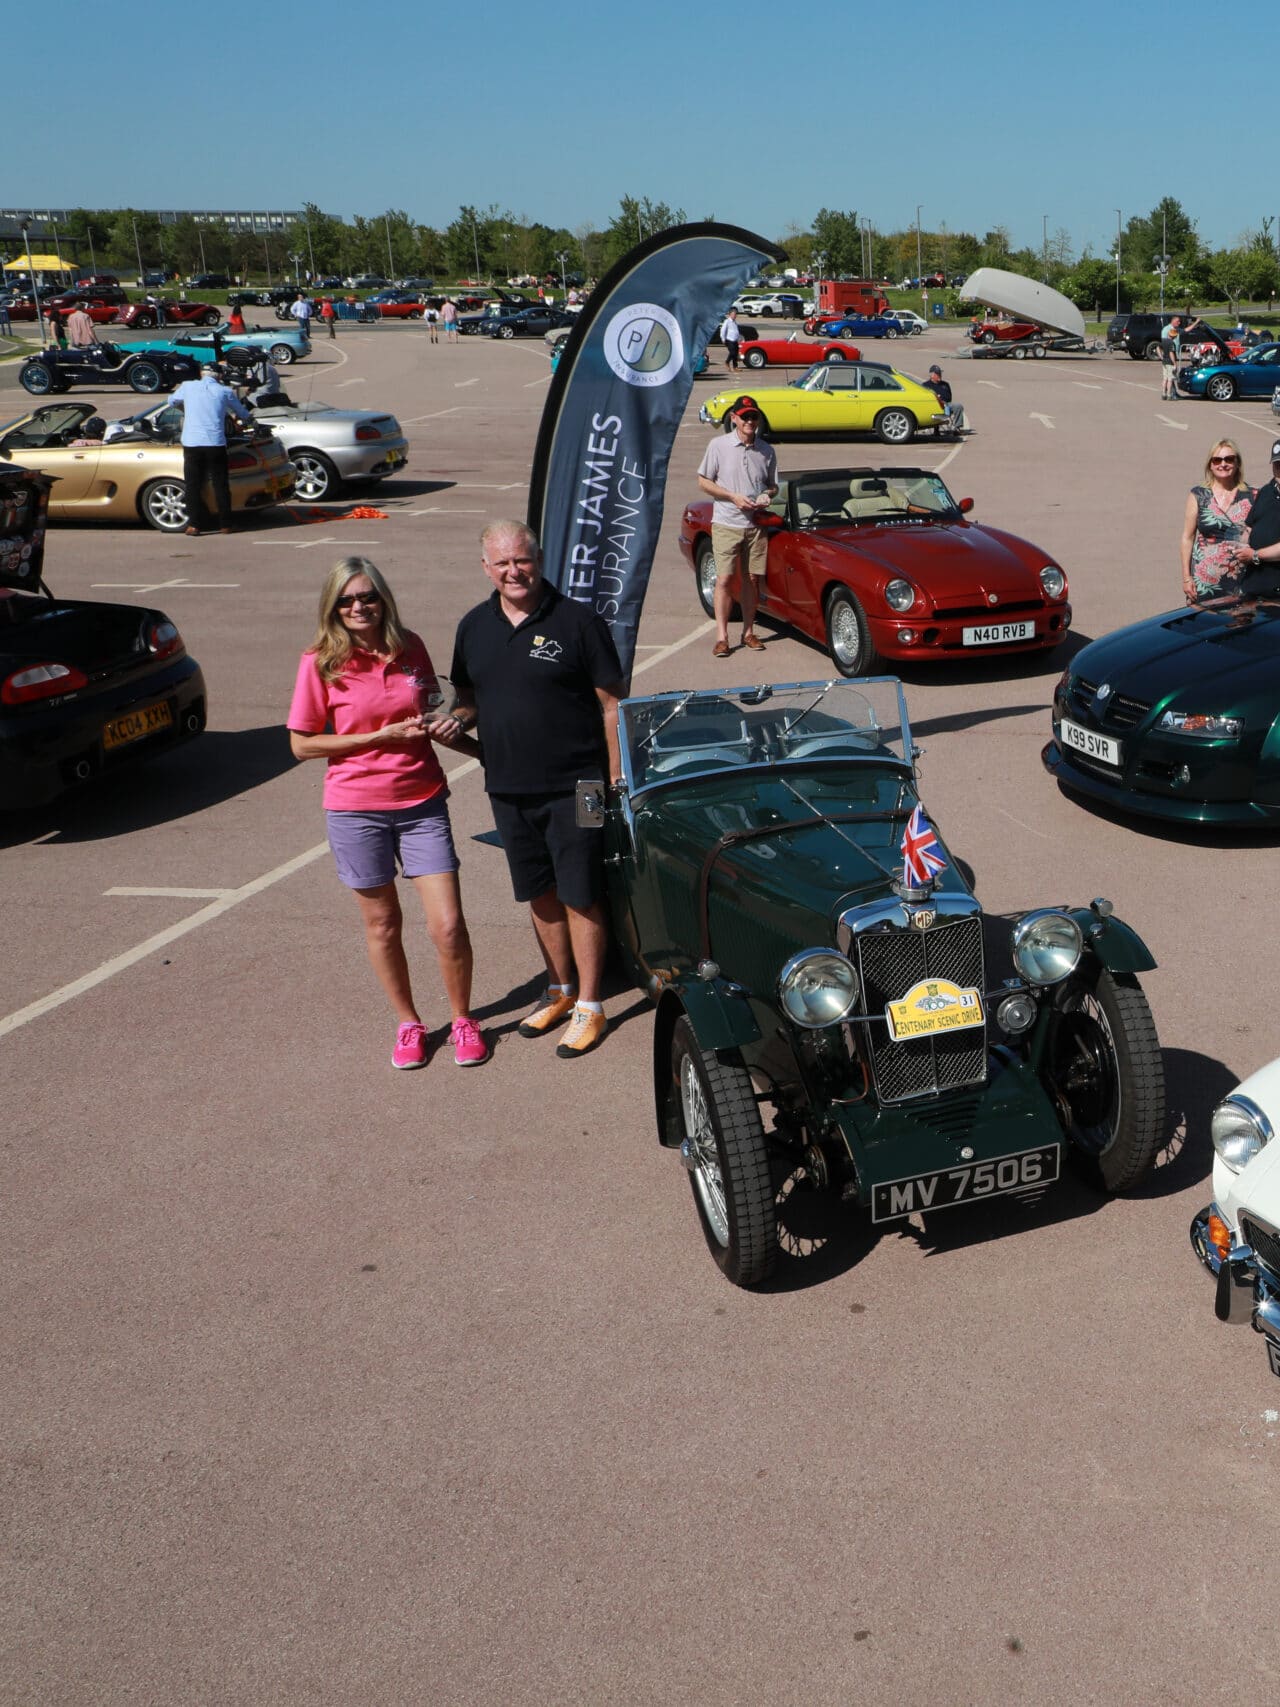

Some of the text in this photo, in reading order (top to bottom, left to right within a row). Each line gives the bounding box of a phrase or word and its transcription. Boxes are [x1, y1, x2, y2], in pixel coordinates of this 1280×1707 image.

[567, 412, 622, 603] TER JAMES
[595, 456, 647, 625] SURANCE
[974, 624, 1026, 642] N40 RVB
[1067, 725, 1110, 758] K99 SVR
[961, 995, 974, 1006] 31
[894, 1019, 936, 1035] CENTENARY
[938, 1013, 961, 1028] SCENIC
[961, 1007, 981, 1023] DRIVE
[890, 1153, 1043, 1215] MV 7506
